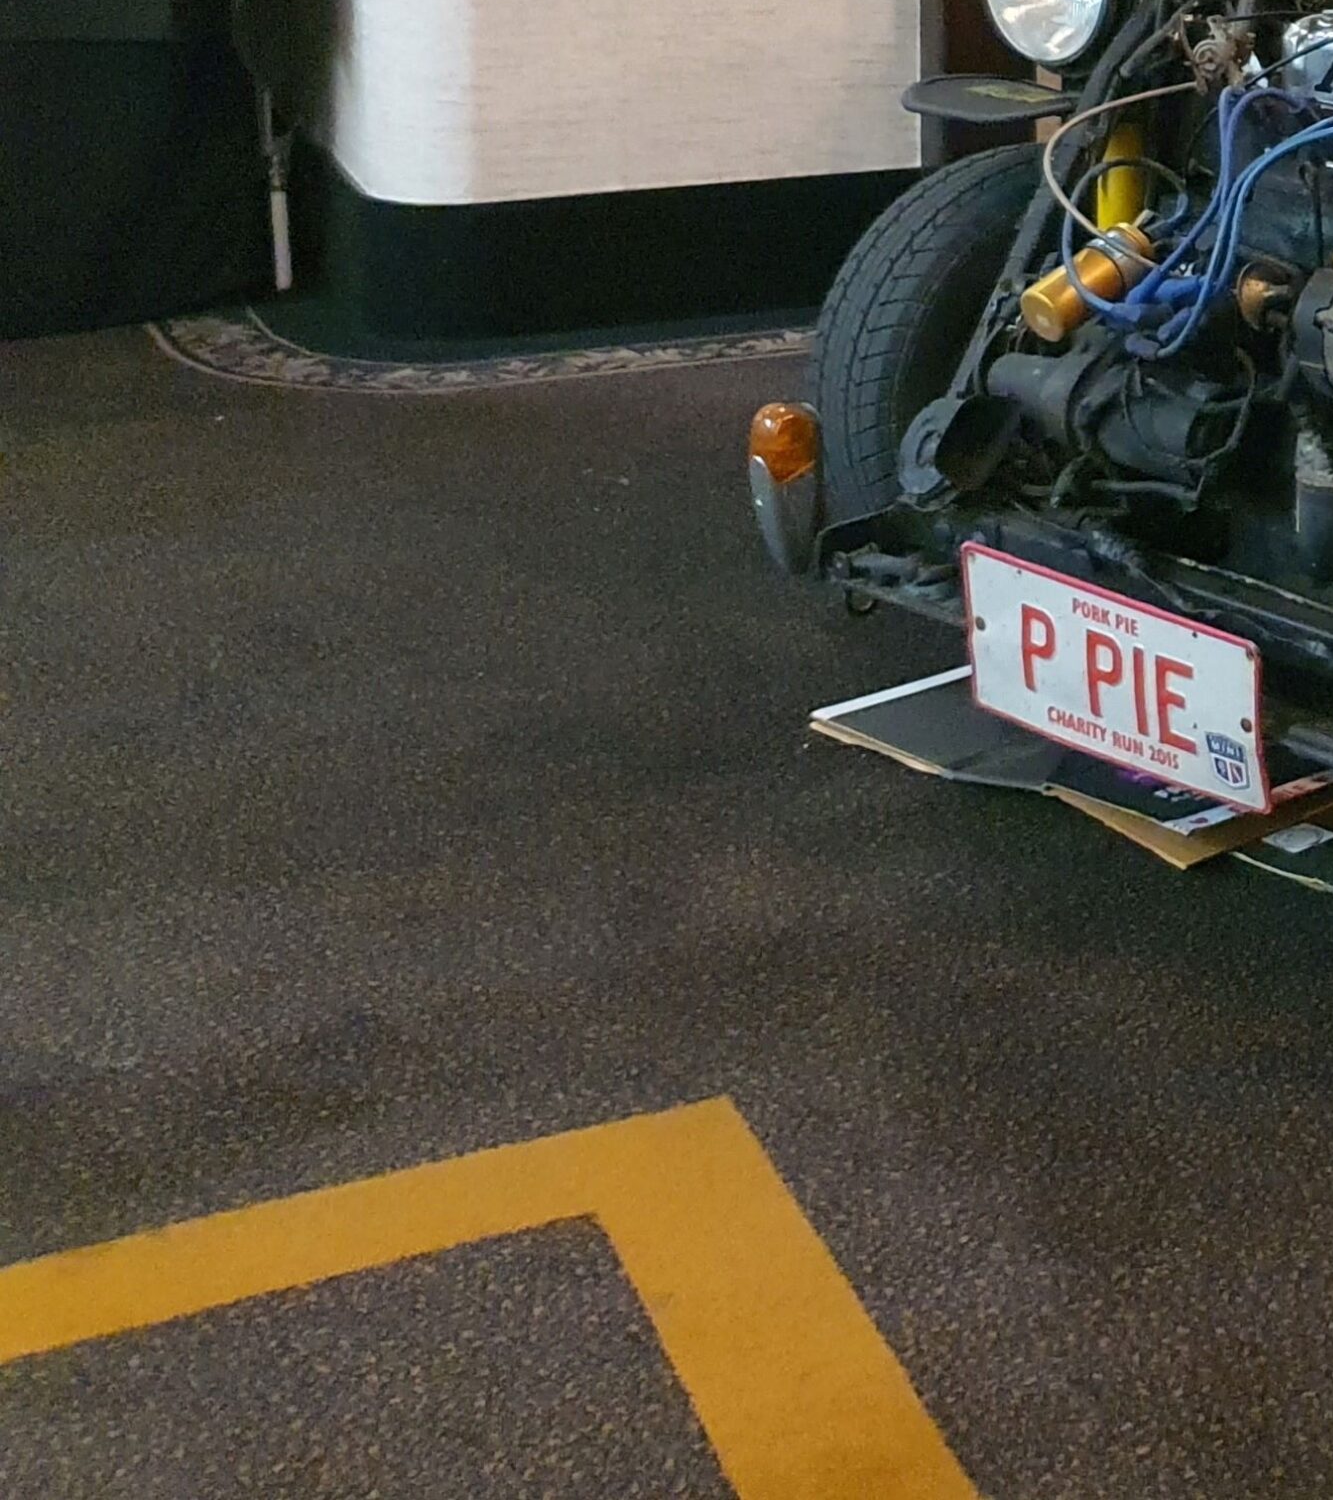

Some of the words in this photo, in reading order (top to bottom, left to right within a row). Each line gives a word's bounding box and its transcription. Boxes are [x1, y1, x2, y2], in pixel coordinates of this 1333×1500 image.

[1072, 597, 1111, 627] PORK
[1115, 612, 1140, 637] PIE
[1021, 603, 1057, 693] P
[1086, 629, 1198, 755] PIE
[1047, 705, 1108, 743] CHARITY
[1112, 731, 1144, 757] RUN
[1148, 744, 1180, 770] 2015
